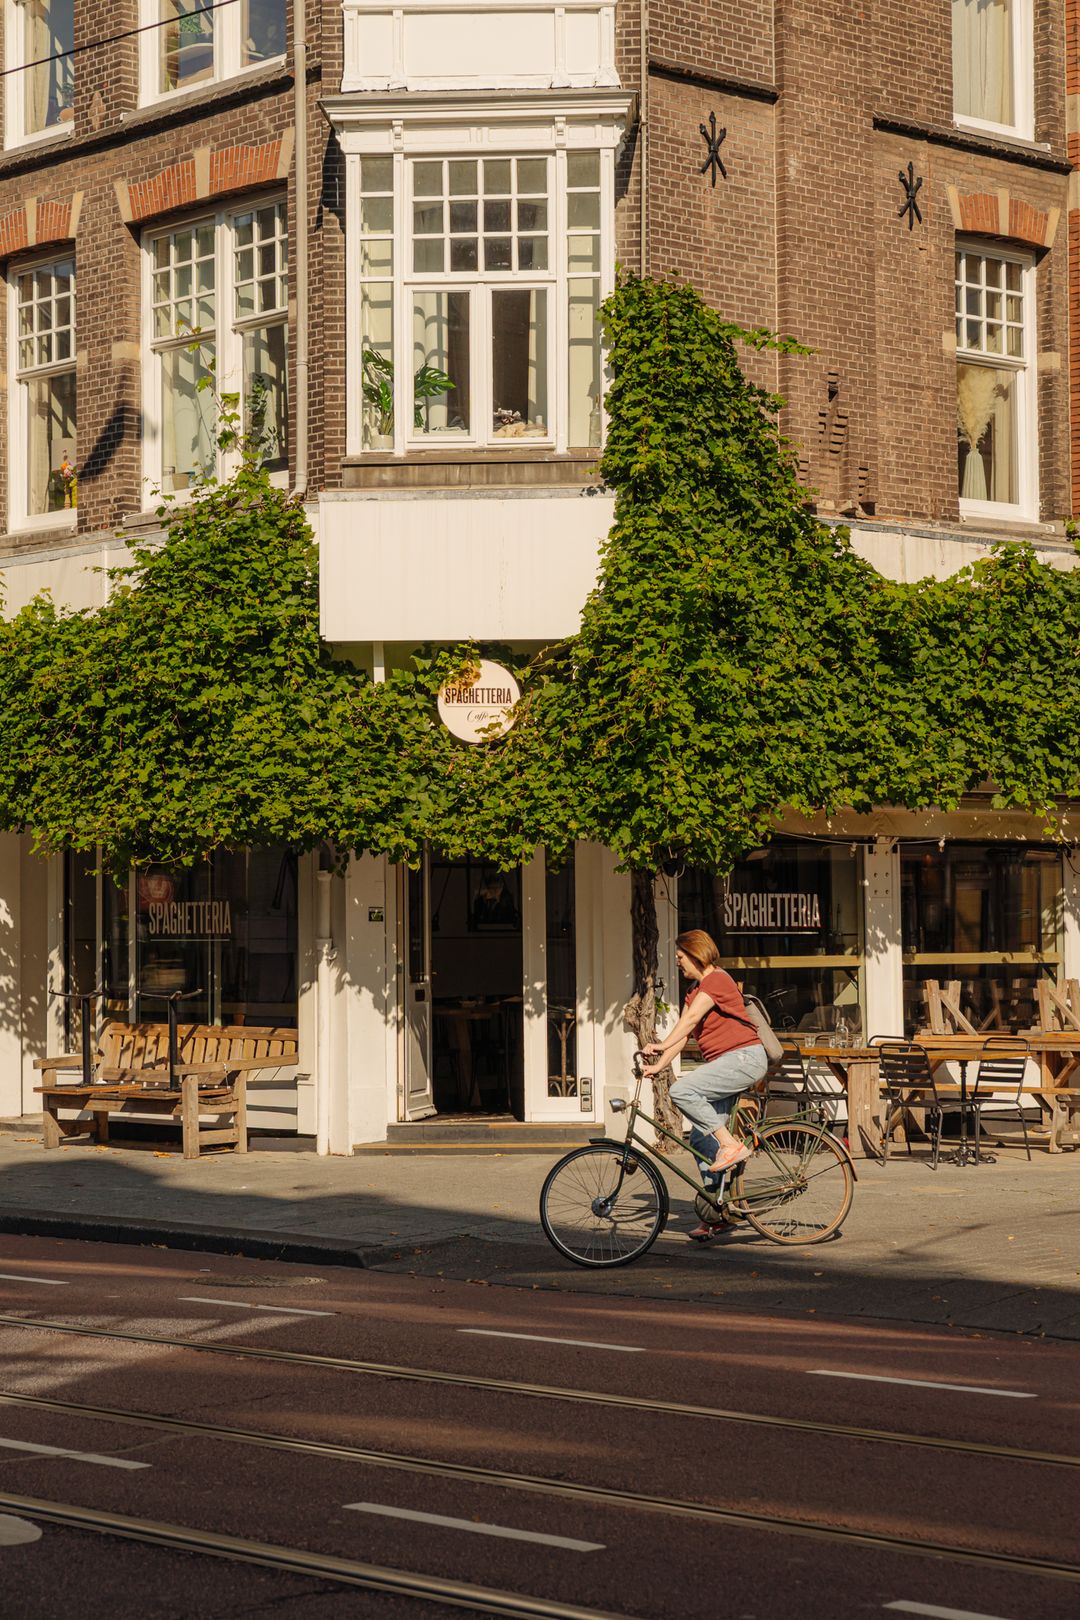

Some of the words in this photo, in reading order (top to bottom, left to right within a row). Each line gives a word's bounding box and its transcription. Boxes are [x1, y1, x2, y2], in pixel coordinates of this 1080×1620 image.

[445, 687, 512, 704] SPAGHETTERIA
[148, 901, 232, 934] SPAGHETTERIA
[723, 892, 821, 928] SPAGHETTERIA
